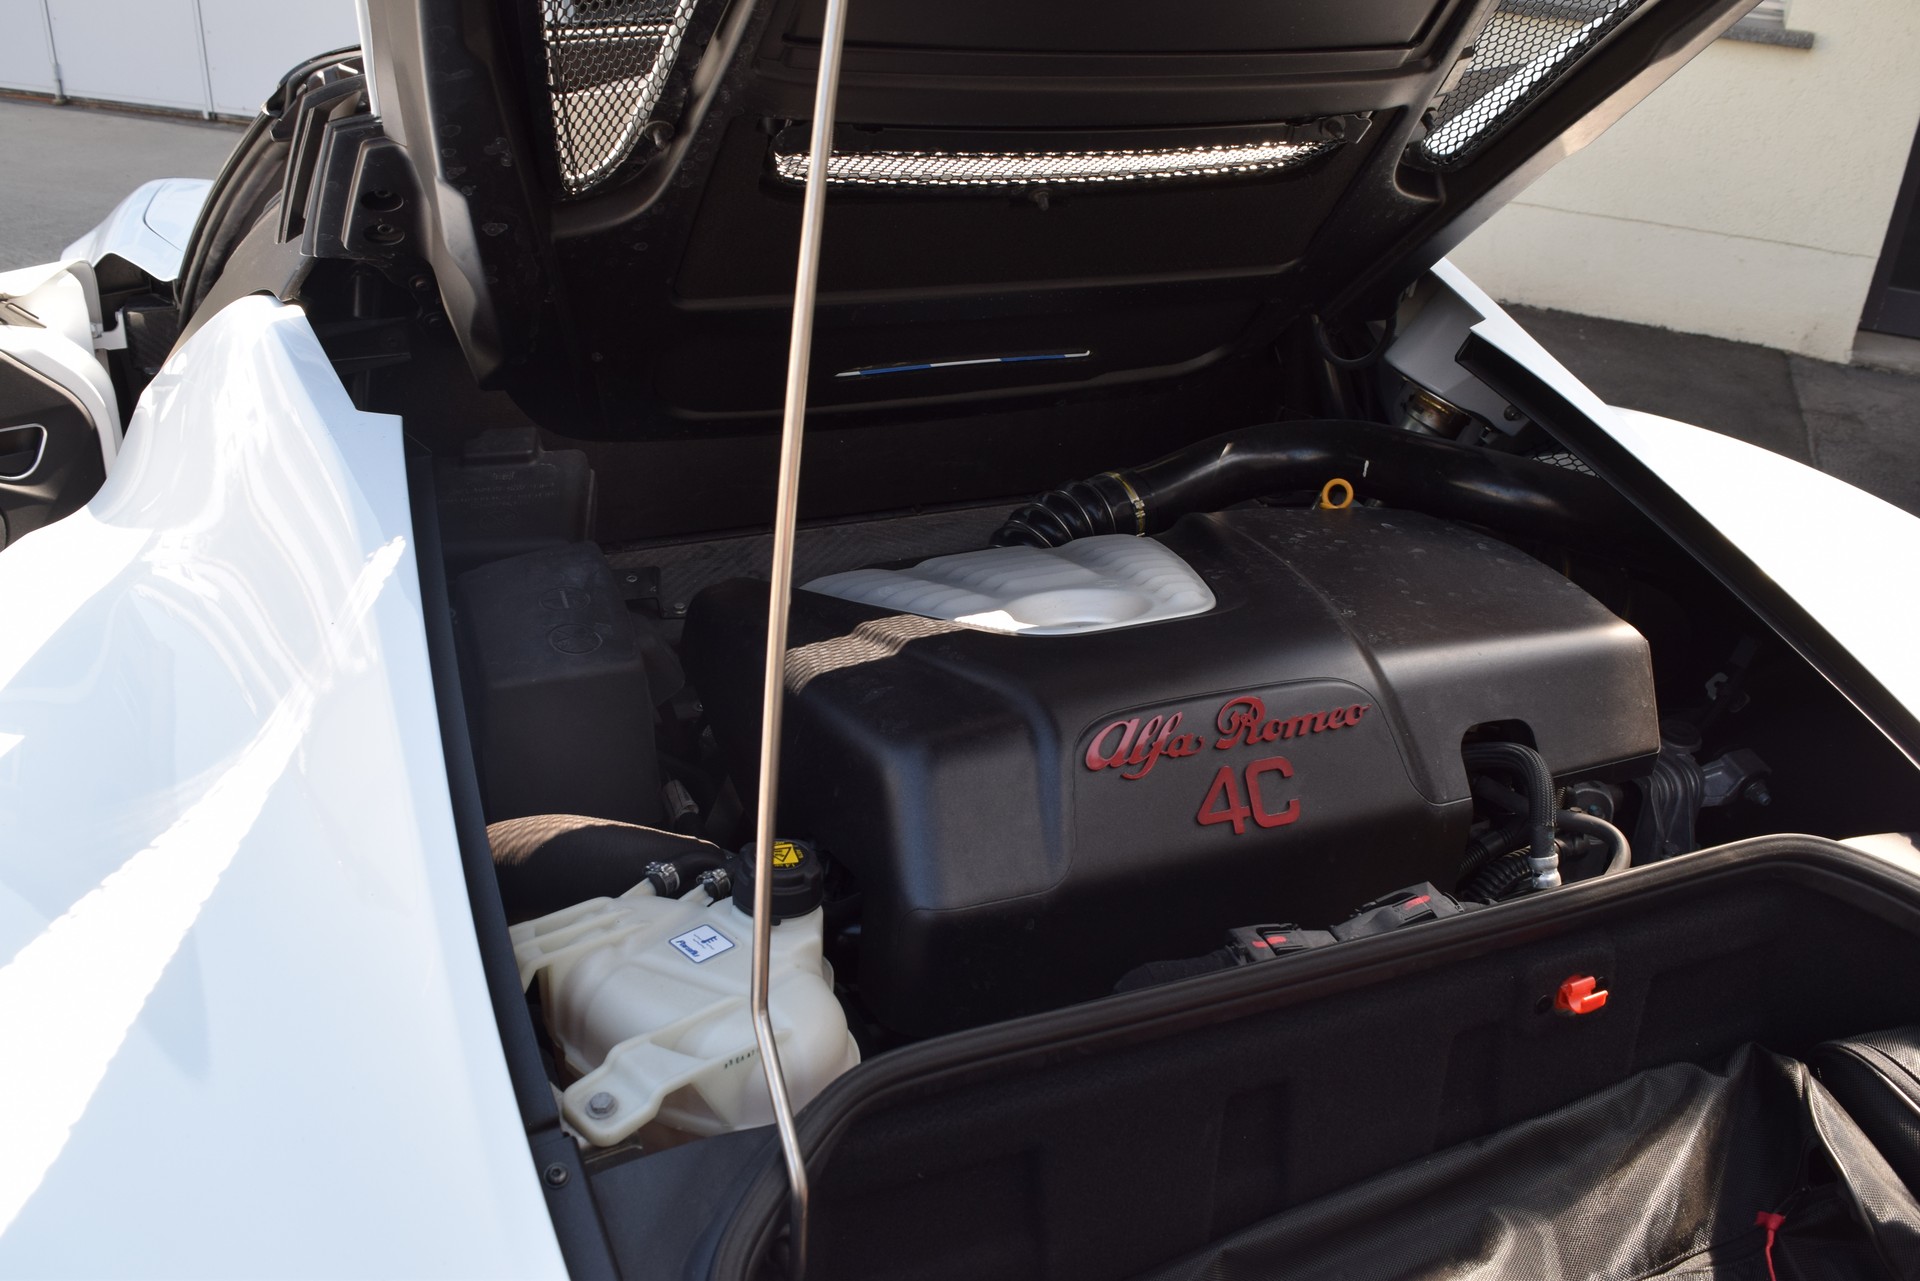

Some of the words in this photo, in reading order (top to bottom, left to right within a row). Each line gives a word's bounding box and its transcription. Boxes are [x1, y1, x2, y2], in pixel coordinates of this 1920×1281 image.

[1085, 711, 1204, 780] Alfa
[1215, 696, 1372, 750] Romeo
[1197, 756, 1301, 834] 4C
